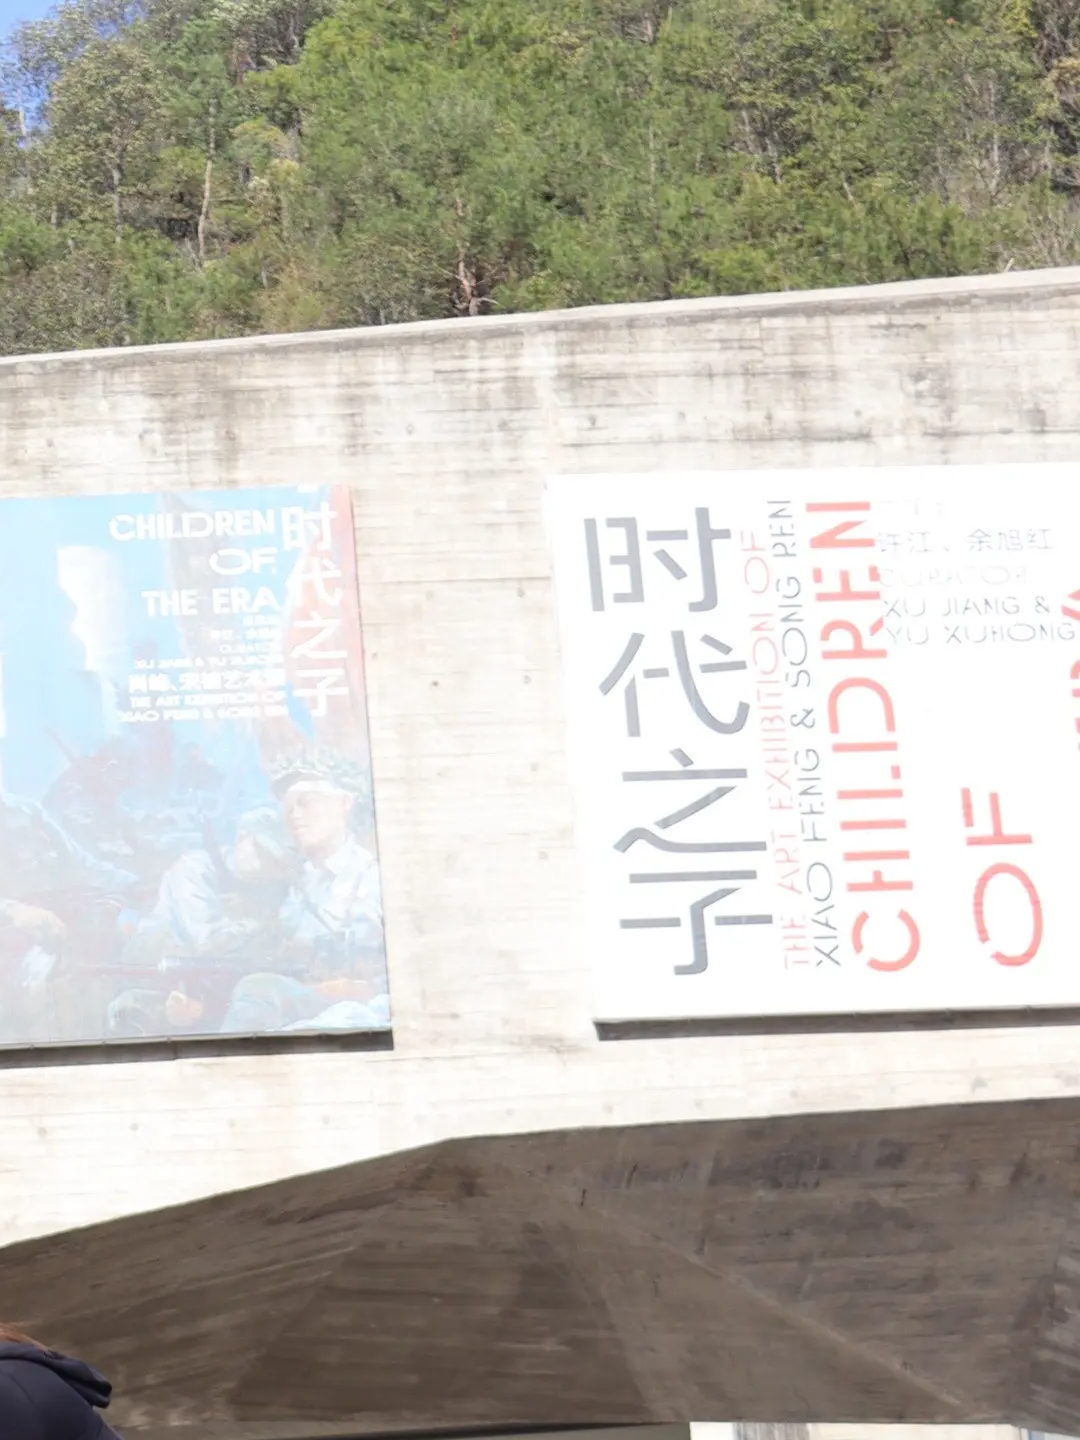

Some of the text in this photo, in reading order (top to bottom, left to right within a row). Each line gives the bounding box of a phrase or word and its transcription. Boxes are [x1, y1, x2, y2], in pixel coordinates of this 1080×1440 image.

[109, 509, 276, 541] CHILDREN
[209, 547, 278, 576] OF
[141, 586, 281, 617] THE ERA
[280, 501, 350, 717] 时代之子
[883, 595, 1051, 618] XU JIANG &
[885, 622, 1076, 645] YU XUHONG
[584, 506, 773, 975] 时代之子
[740, 528, 810, 970] THE ART EXHIBITION OF
[767, 499, 841, 969] XIAO FENG & SONG REN
[805, 500, 921, 973] CHILDREN
[960, 786, 1043, 967] OF
